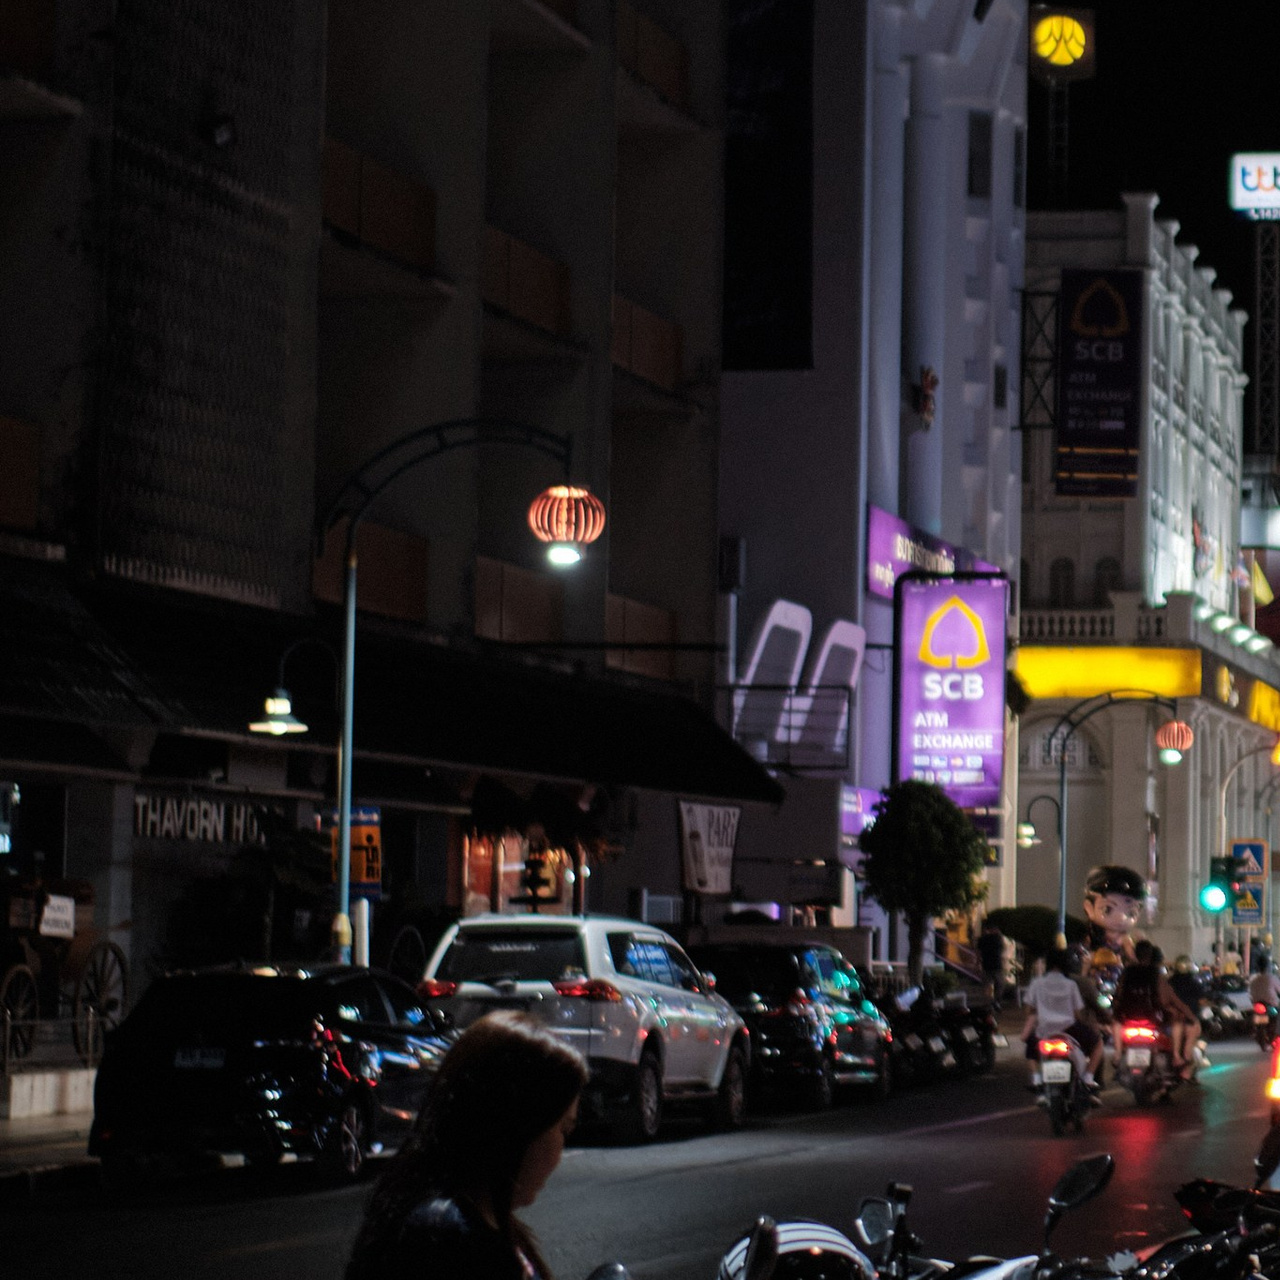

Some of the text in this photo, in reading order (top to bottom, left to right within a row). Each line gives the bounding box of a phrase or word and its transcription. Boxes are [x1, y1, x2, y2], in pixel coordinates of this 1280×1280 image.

[1074, 341, 1125, 362] SCB
[923, 672, 985, 701] SCB
[914, 711, 949, 728] ATM
[912, 733, 994, 749] EXCHANGE
[134, 794, 226, 844] THAVORN
